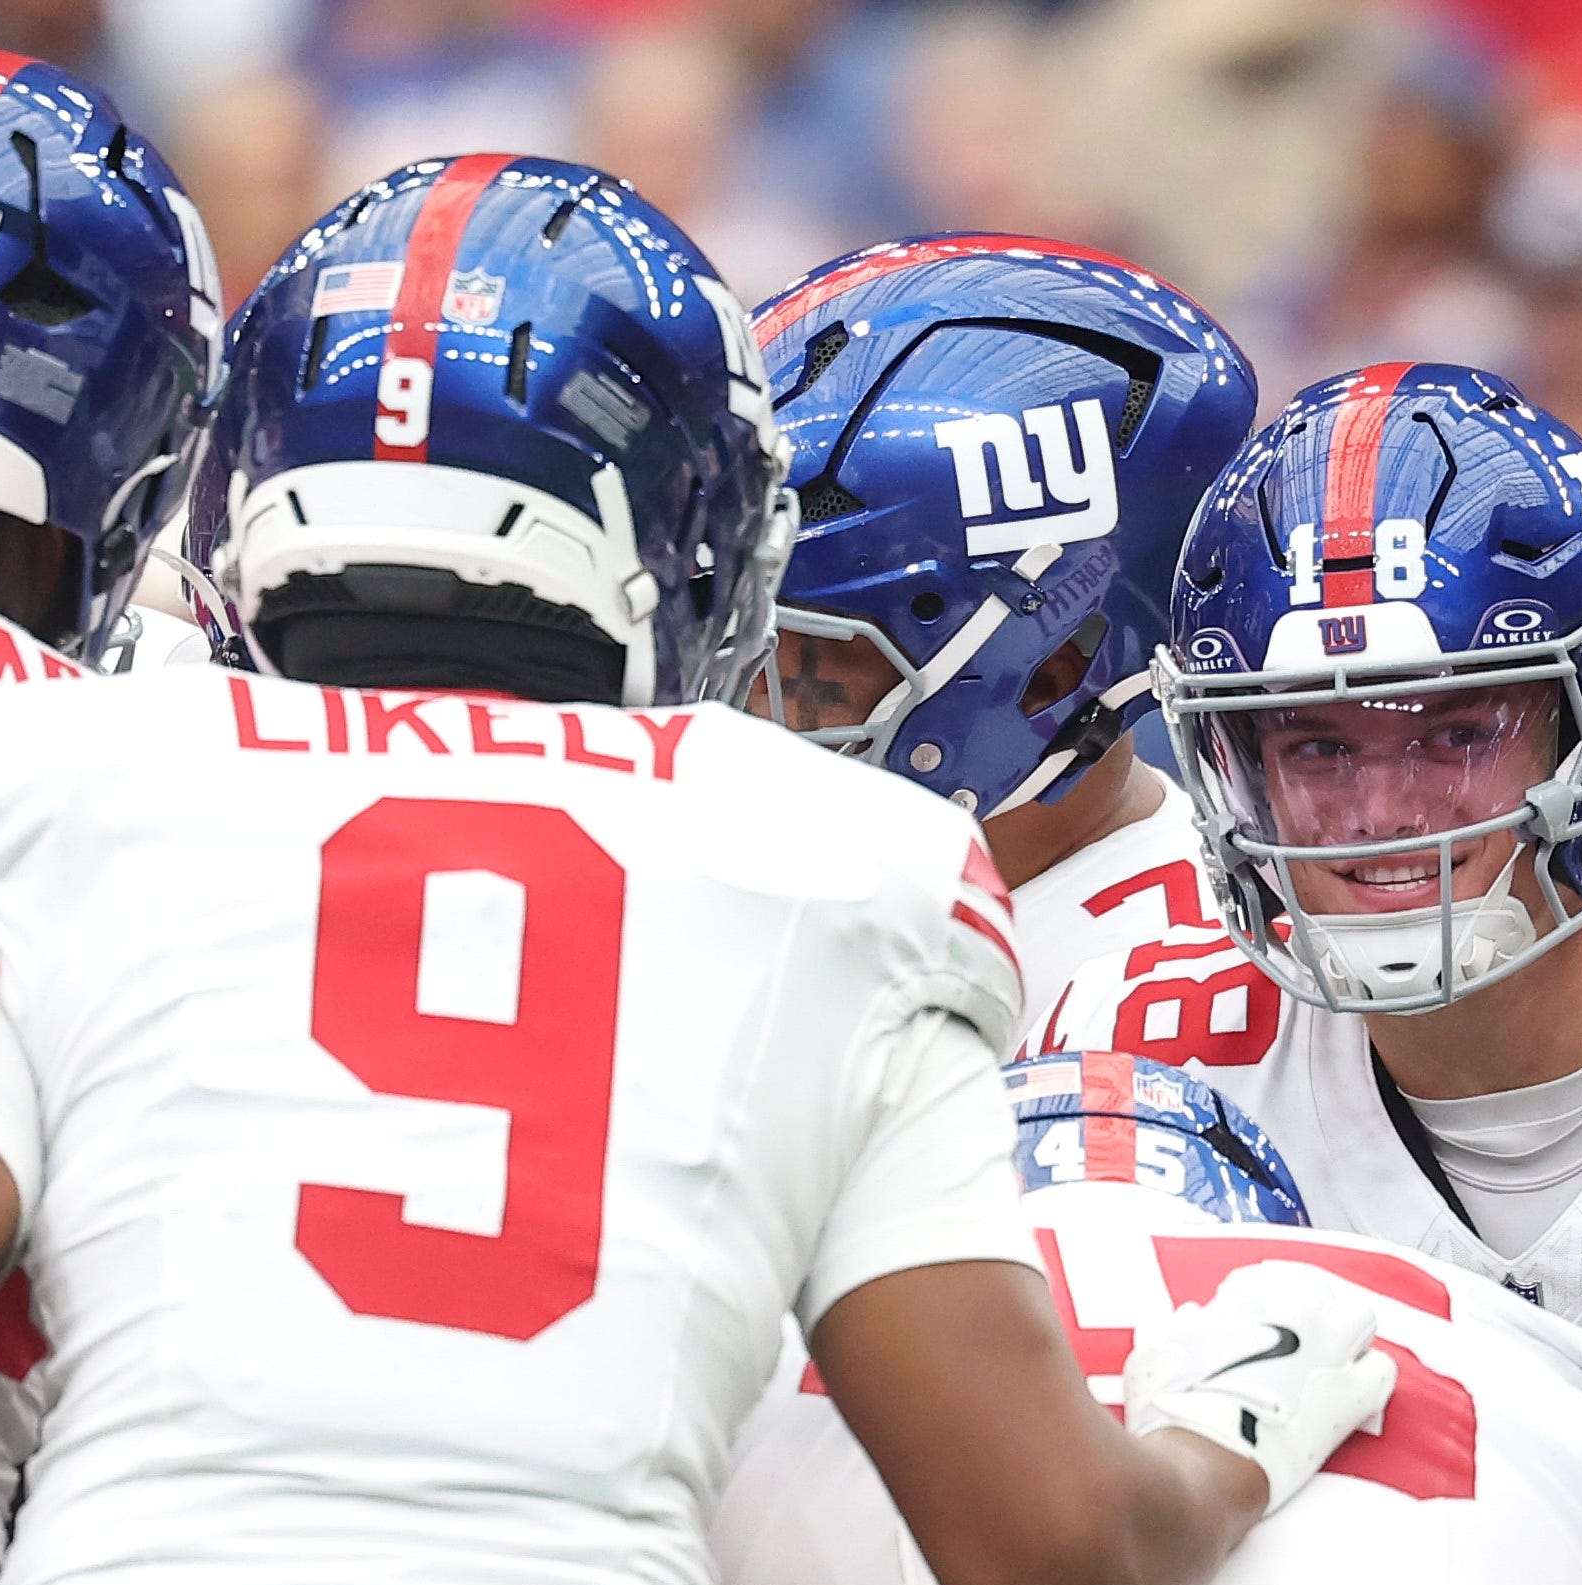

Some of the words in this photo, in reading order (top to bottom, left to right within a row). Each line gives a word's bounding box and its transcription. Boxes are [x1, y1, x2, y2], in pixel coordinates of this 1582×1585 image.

[375, 356, 435, 447] 9
[933, 398, 1120, 557] ny
[1284, 518, 1430, 606] 18
[1318, 614, 1367, 656] ny
[1482, 631, 1554, 644] OAKLEY
[228, 676, 697, 783] LIKELY
[294, 796, 626, 1342] 9
